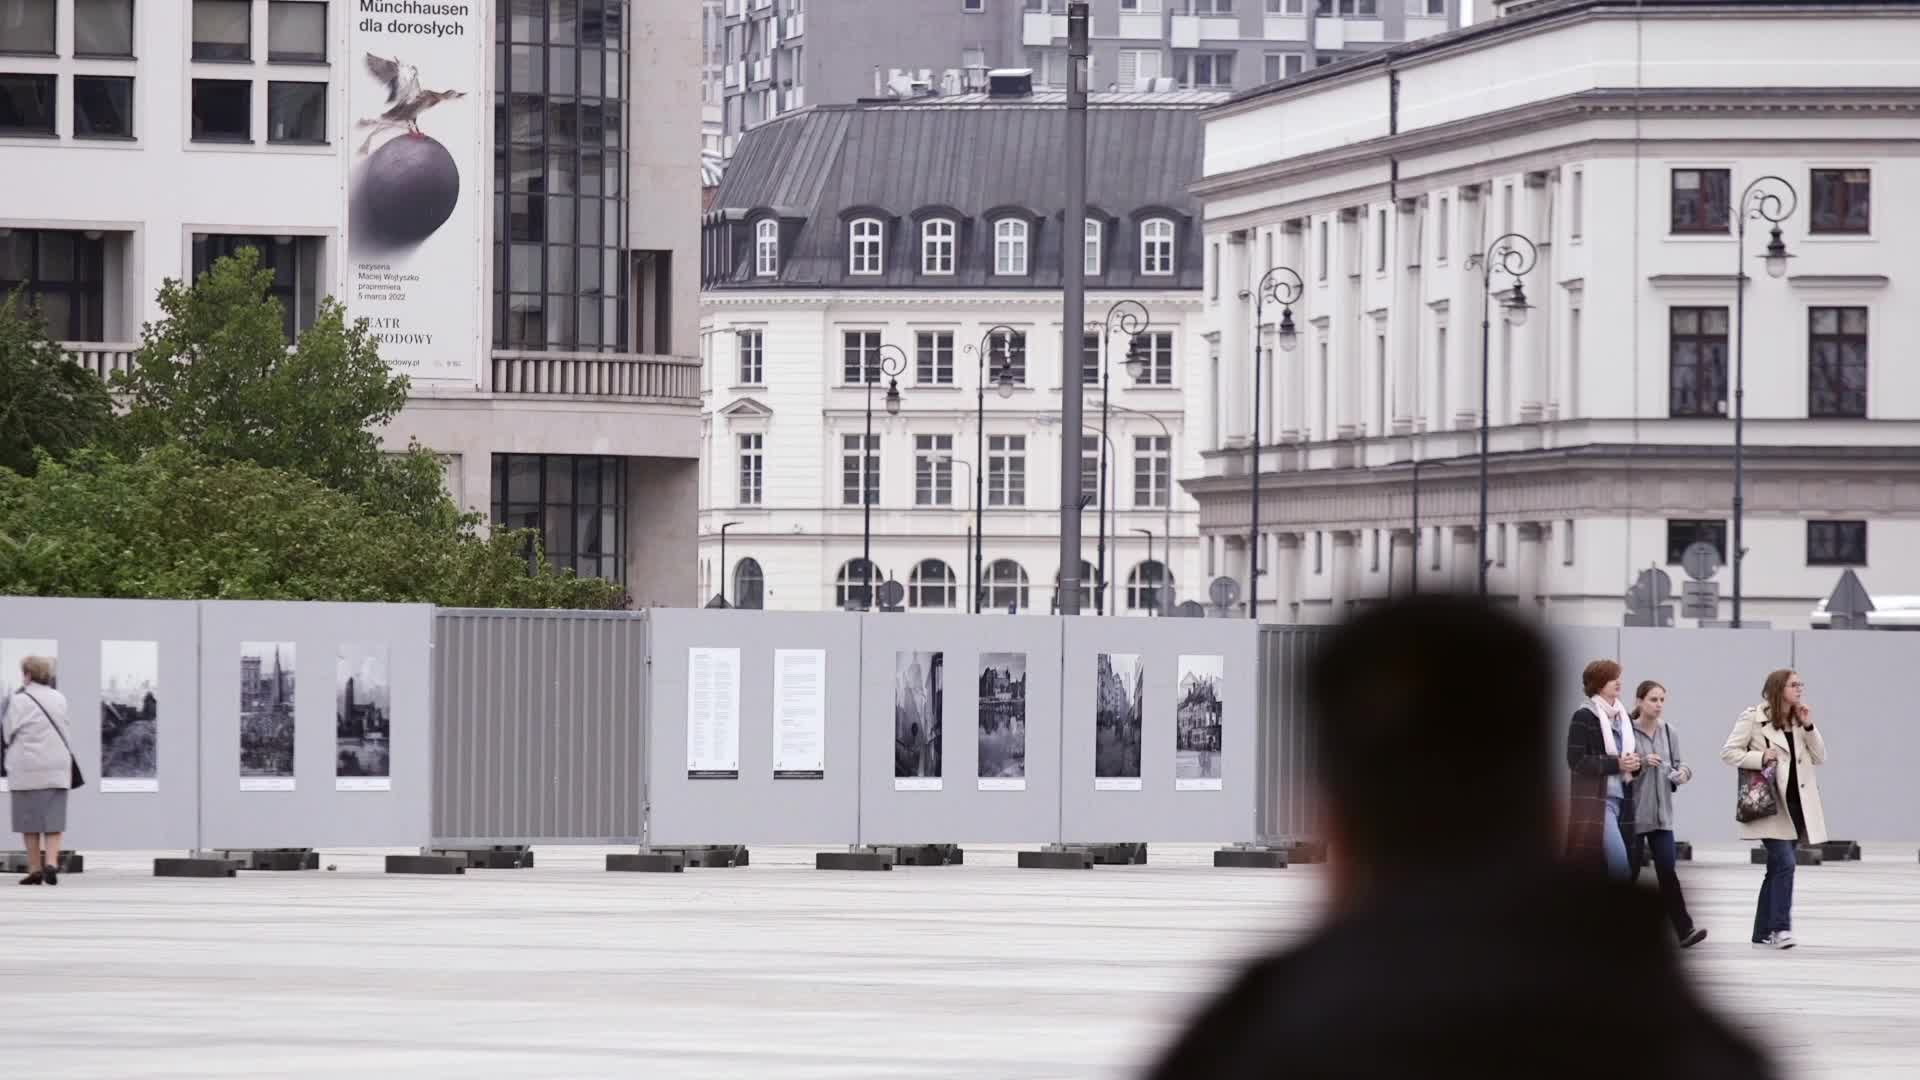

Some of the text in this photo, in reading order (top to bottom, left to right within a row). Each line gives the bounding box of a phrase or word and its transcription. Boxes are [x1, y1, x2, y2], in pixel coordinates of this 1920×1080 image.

[360, 0, 468, 16] Münchhausen
[359, 18, 464, 38] dla dorosłych
[358, 273, 420, 282] Maciej Wojtyszko
[388, 293, 406, 301] 2022
[362, 317, 401, 329] EATR
[367, 333, 433, 345] RODOWY
